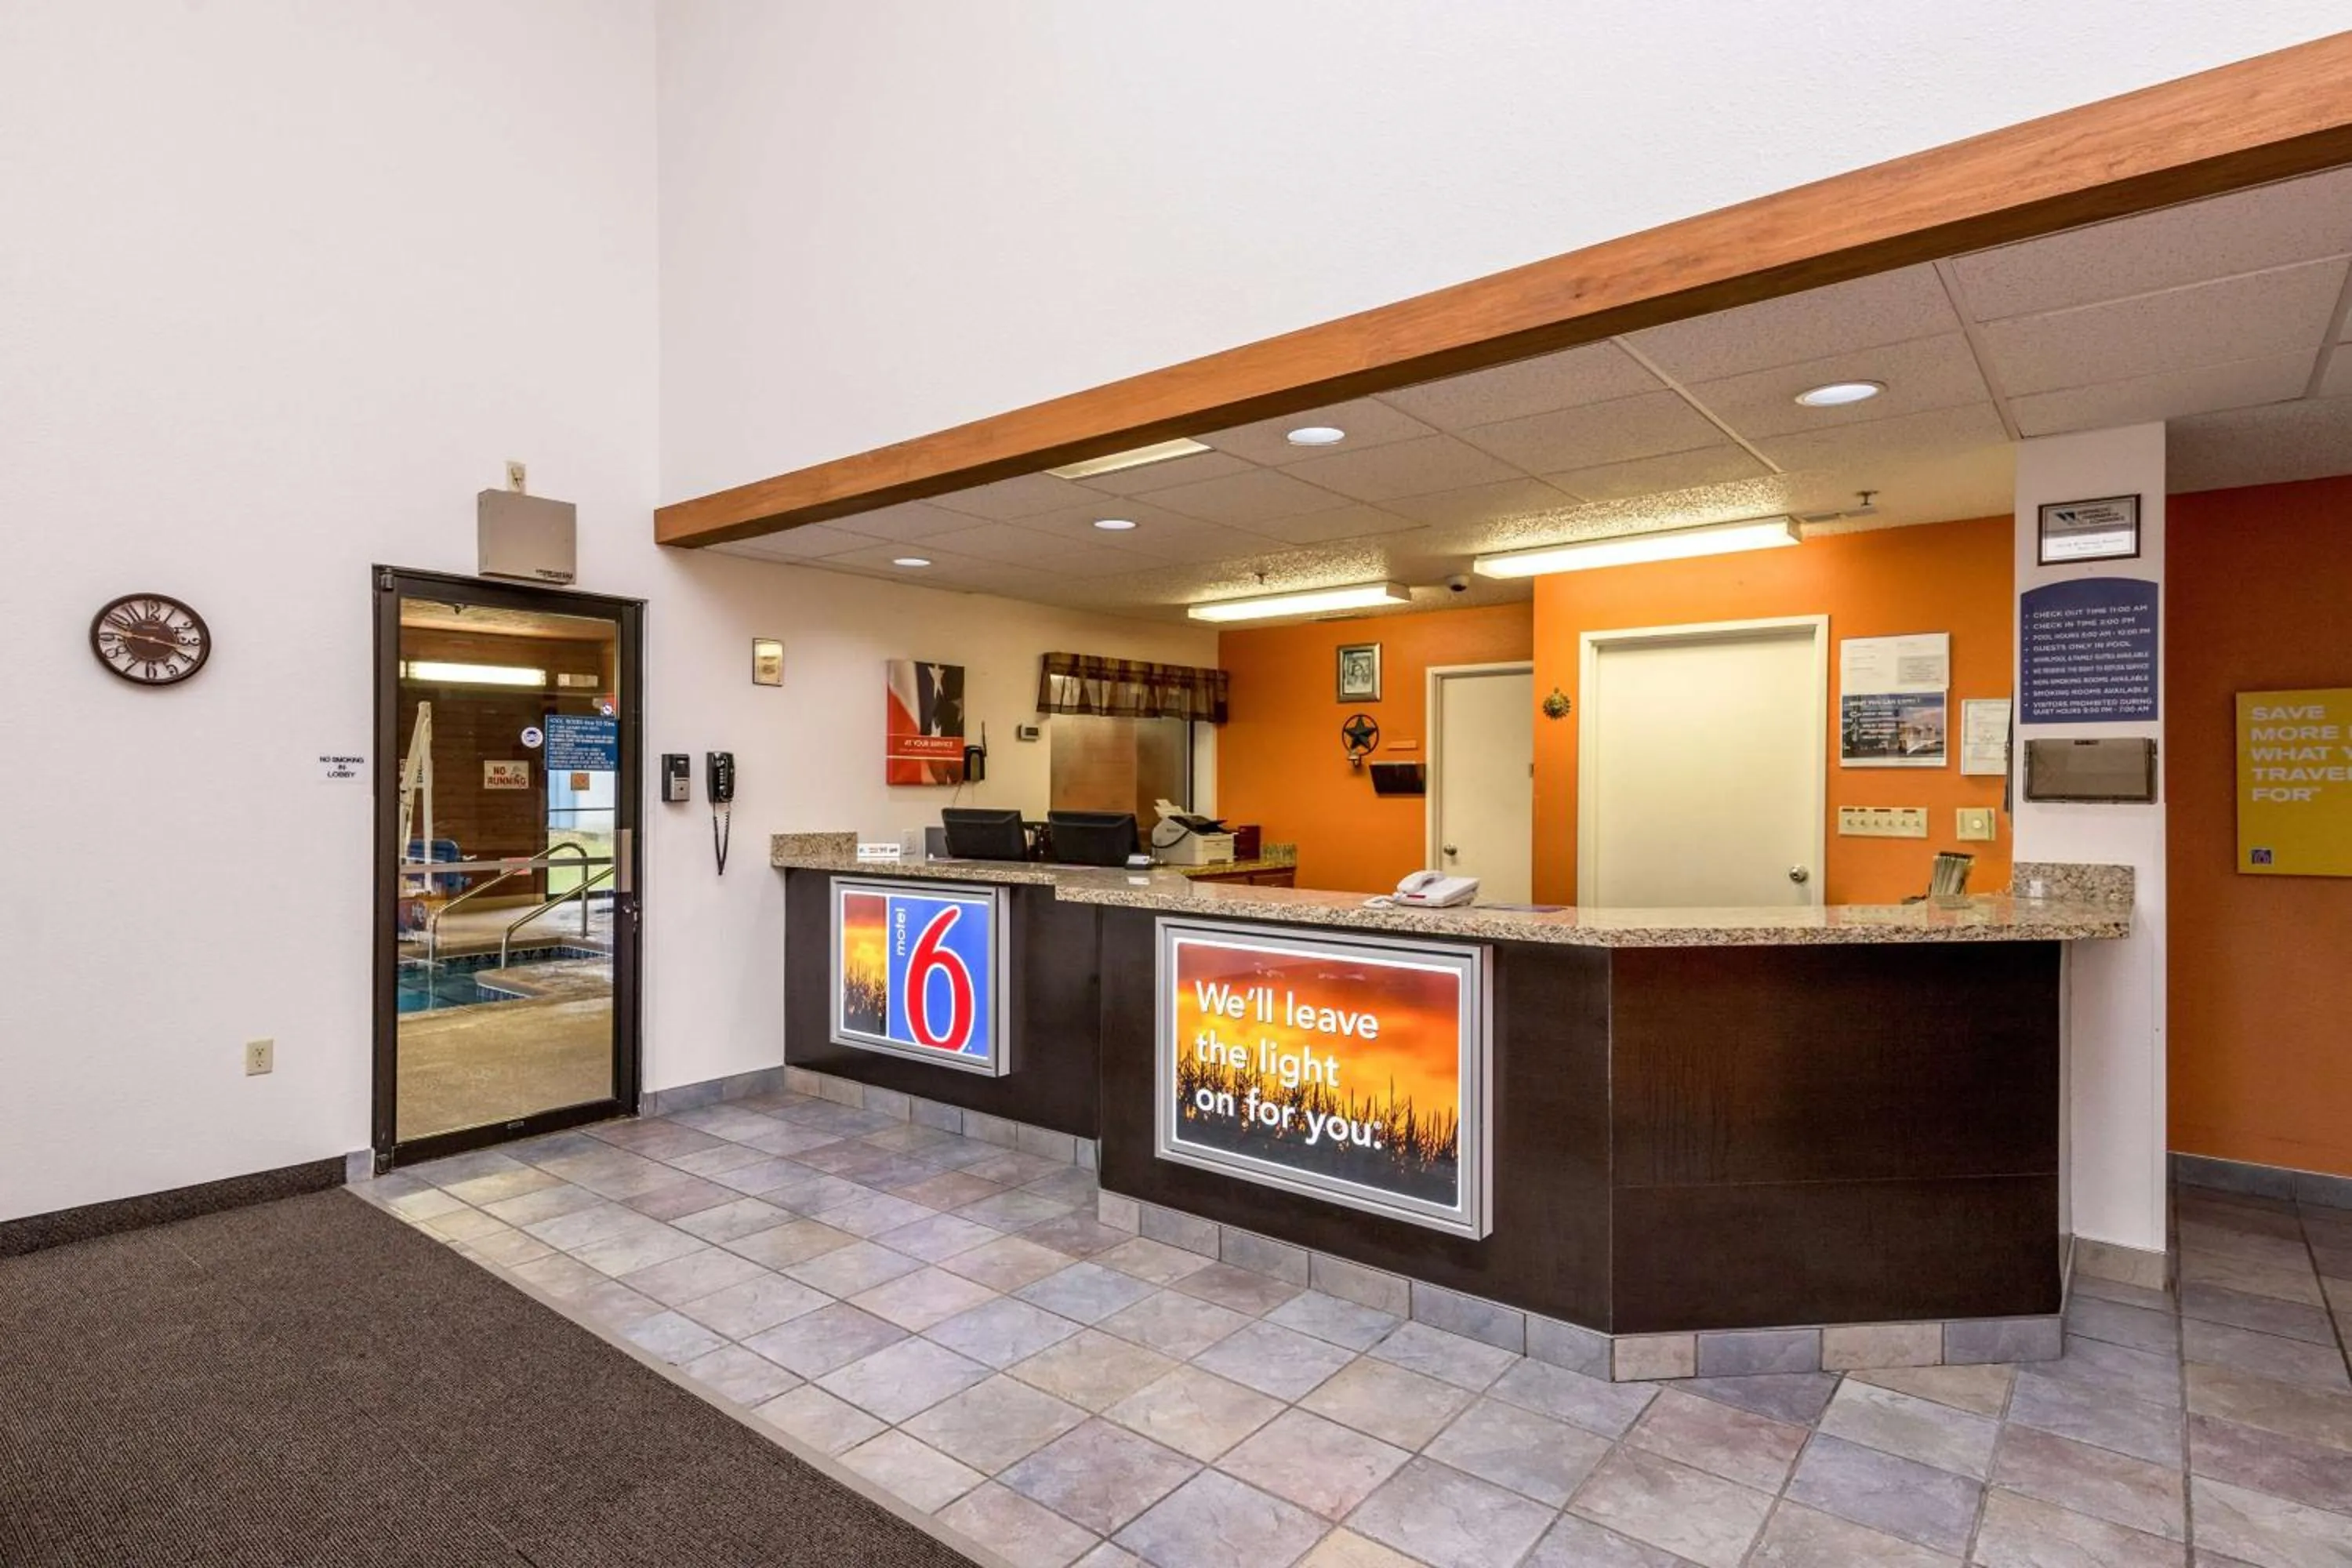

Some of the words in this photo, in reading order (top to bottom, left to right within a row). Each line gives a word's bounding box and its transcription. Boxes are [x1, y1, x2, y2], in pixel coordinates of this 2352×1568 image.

[2252, 705, 2325, 721] SAVE
[2250, 725, 2339, 742] MORE
[2252, 746, 2333, 761] WHAT
[487, 775, 527, 786] RUNNING
[493, 765, 506, 776] NO
[895, 907, 906, 957] motel
[904, 905, 975, 1054] 6
[1195, 980, 1273, 1024] We'll
[1286, 991, 1380, 1040] leave
[1195, 1030, 1248, 1070] the
[1258, 1037, 1341, 1088] light
[1195, 1088, 1235, 1117] on
[1247, 1087, 1297, 1131] for
